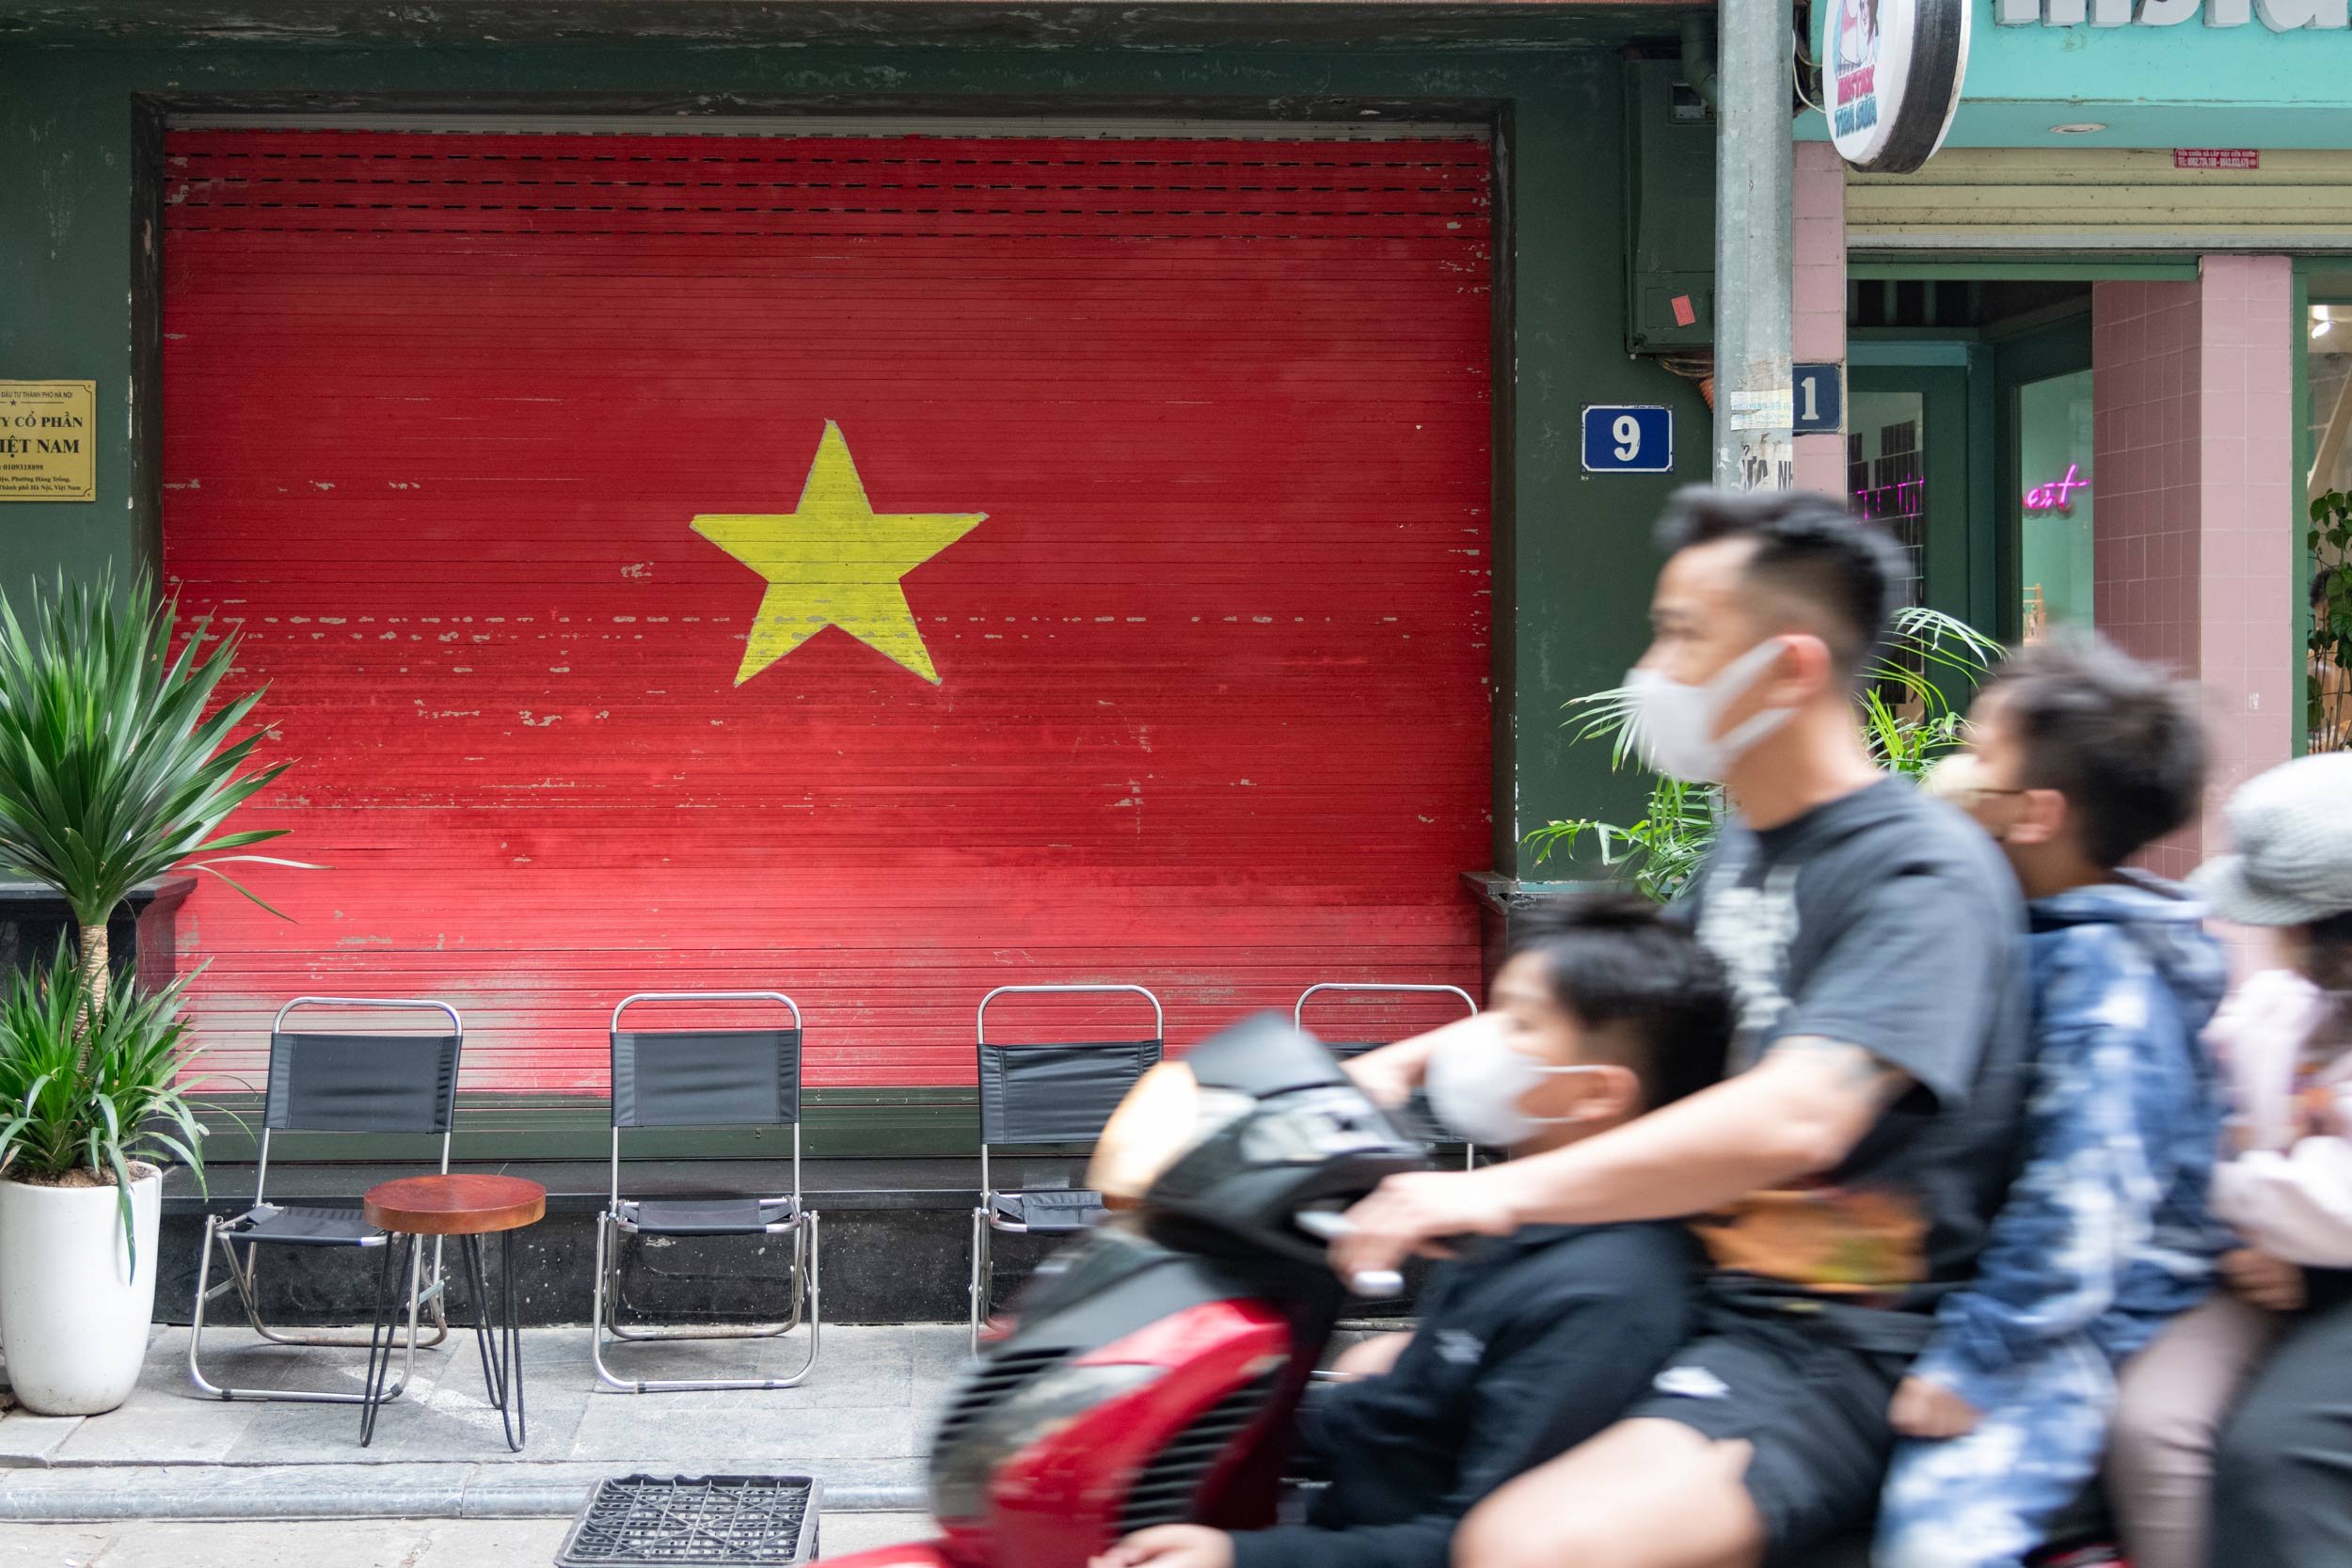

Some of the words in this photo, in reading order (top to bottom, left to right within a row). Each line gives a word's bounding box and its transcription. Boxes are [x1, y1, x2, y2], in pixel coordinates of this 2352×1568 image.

[1837, 64, 1875, 107] INSTAX
[14, 410, 37, 428] CỔ
[41, 411, 83, 428] PHẦN
[37, 438, 80, 453] NAM
[1613, 415, 1641, 462] 9
